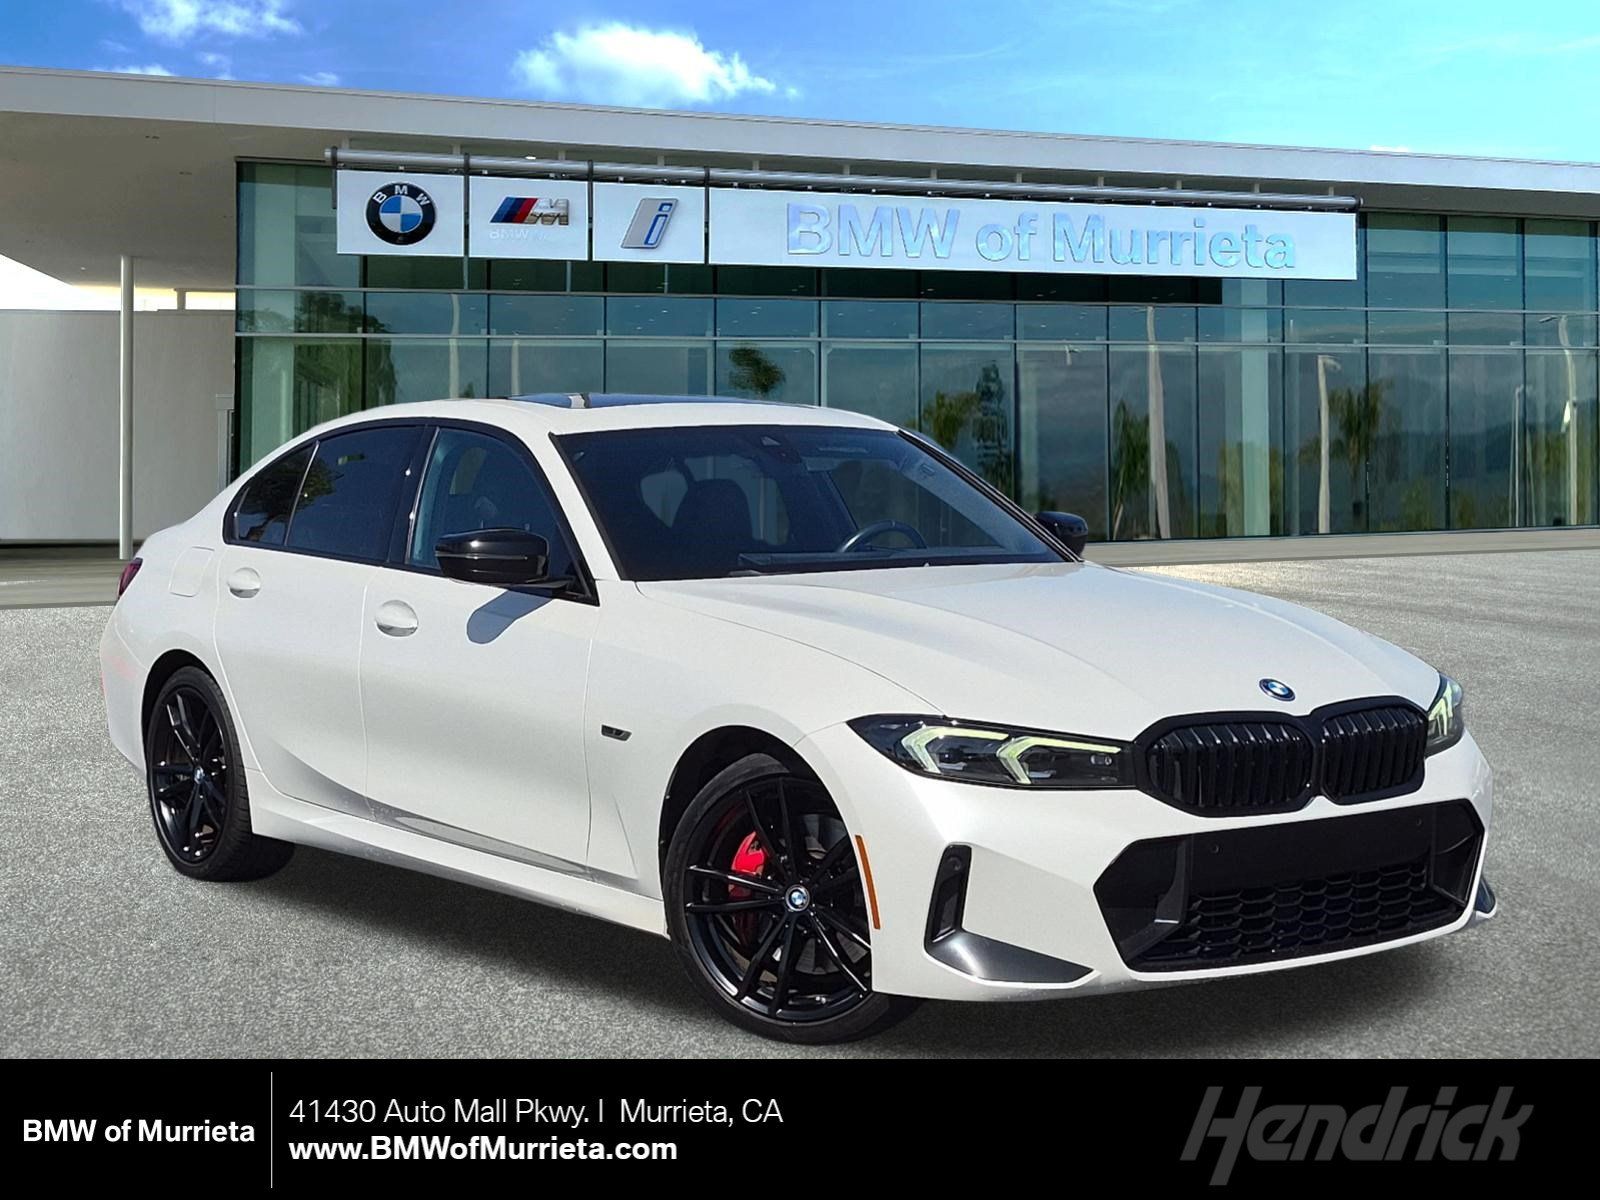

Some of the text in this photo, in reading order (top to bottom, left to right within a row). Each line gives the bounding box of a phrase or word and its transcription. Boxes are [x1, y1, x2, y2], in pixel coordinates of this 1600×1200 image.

[372, 184, 431, 206] BMW
[786, 202, 1297, 270] BMW of Murrieta
